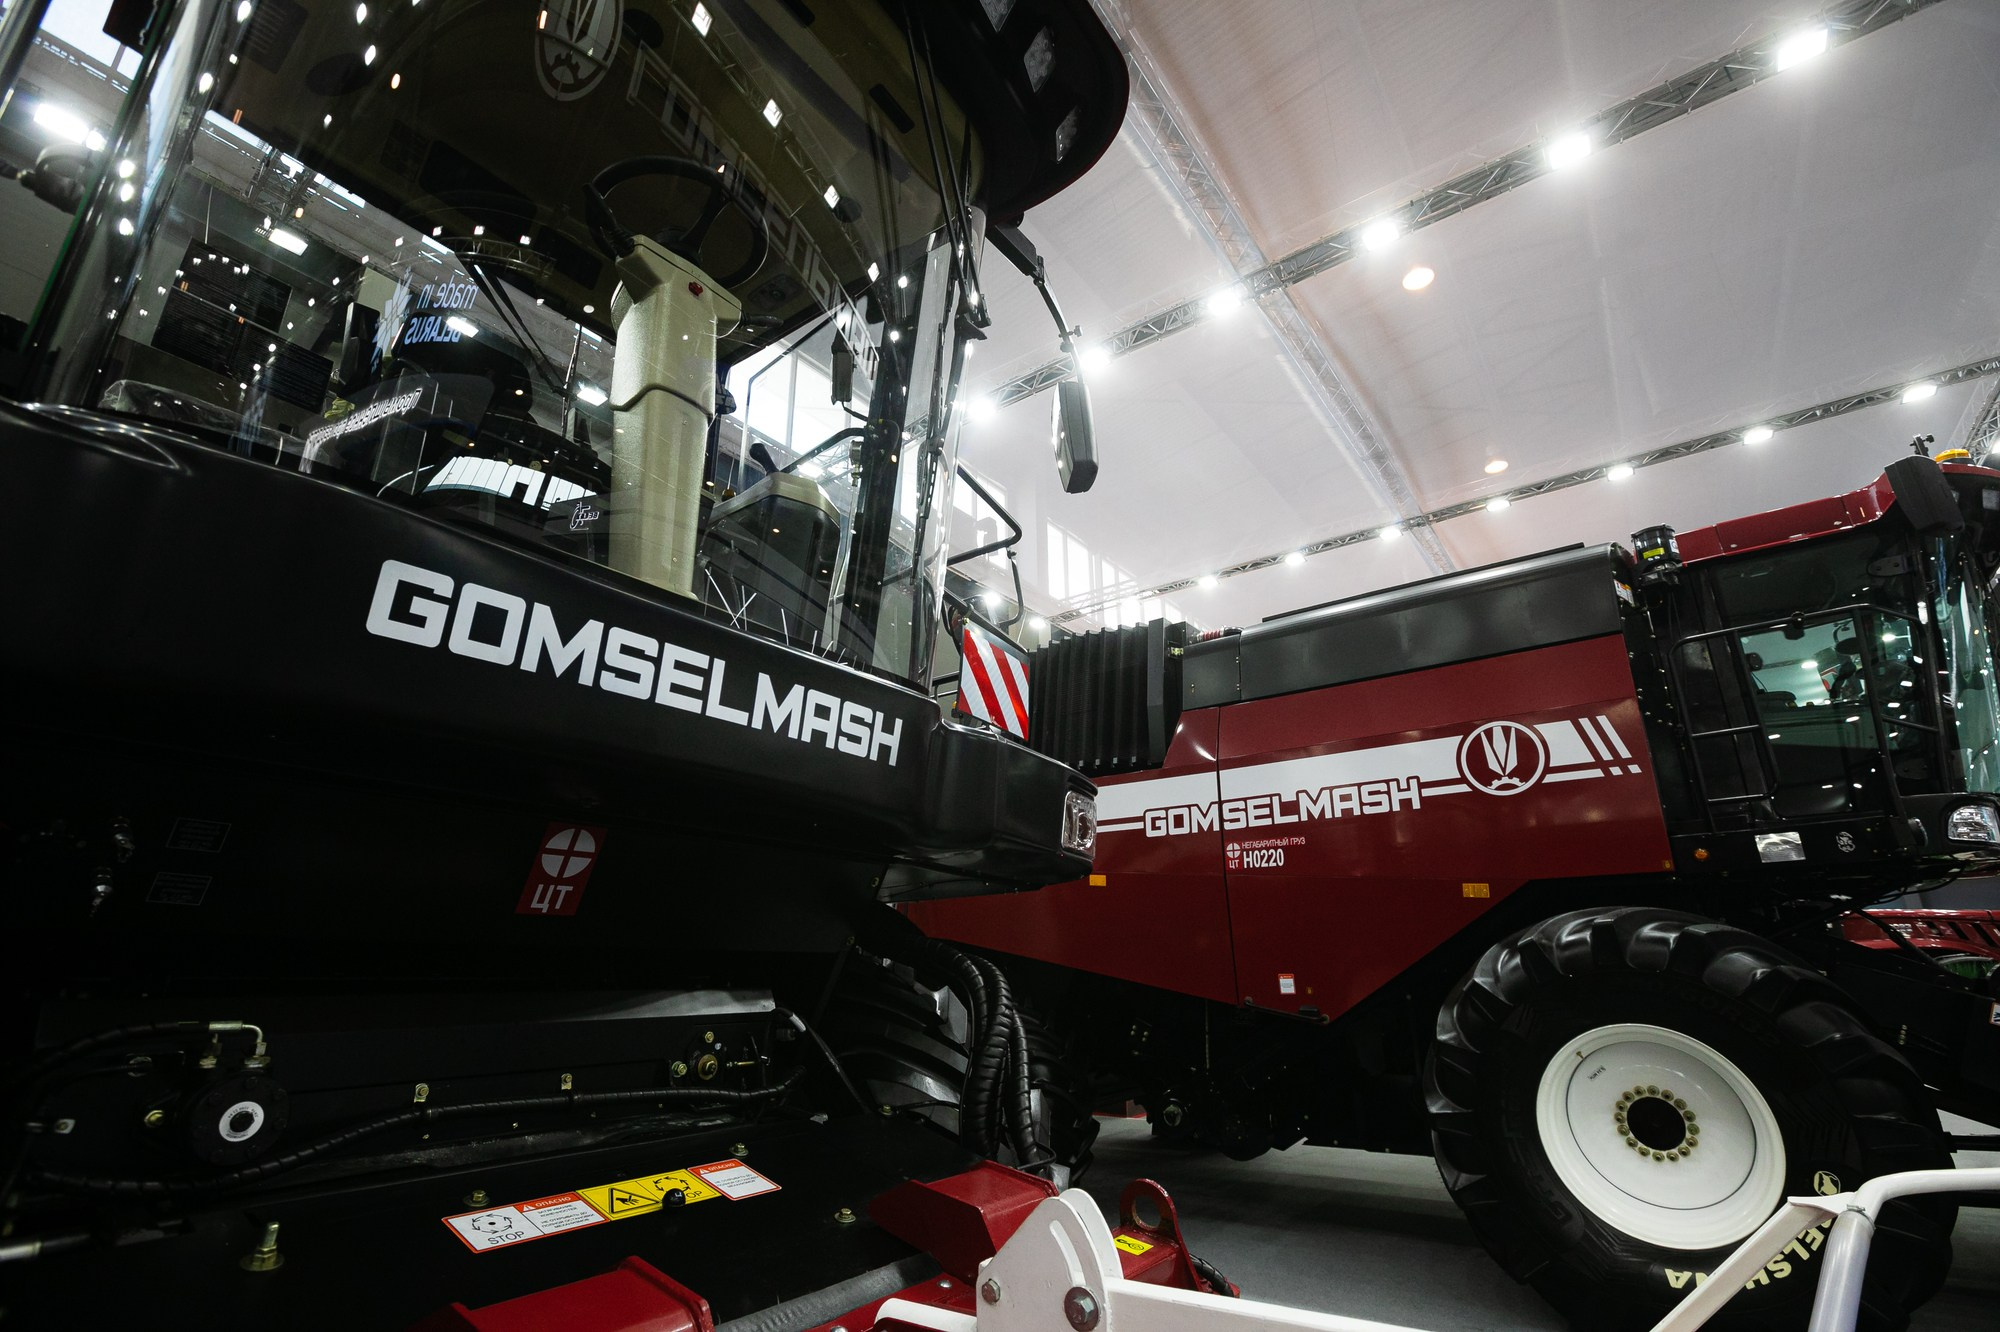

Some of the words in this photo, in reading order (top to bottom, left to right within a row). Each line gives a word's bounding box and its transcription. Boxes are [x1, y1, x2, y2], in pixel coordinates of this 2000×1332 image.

[366, 559, 903, 767] GOMSELMASH
[1145, 777, 1421, 838] GOMSELMASH
[1241, 837, 1289, 849] НЕГАБАРИТНЫЙ
[1289, 836, 1306, 845] ГРУЗ
[1228, 859, 1240, 869] ЦТ
[530, 883, 574, 913] ЦТ
[707, 1162, 736, 1172] ОПАСНО
[685, 1190, 703, 1199] OP
[535, 1196, 572, 1207] ОПАСНО
[487, 1231, 525, 1245] STOP
